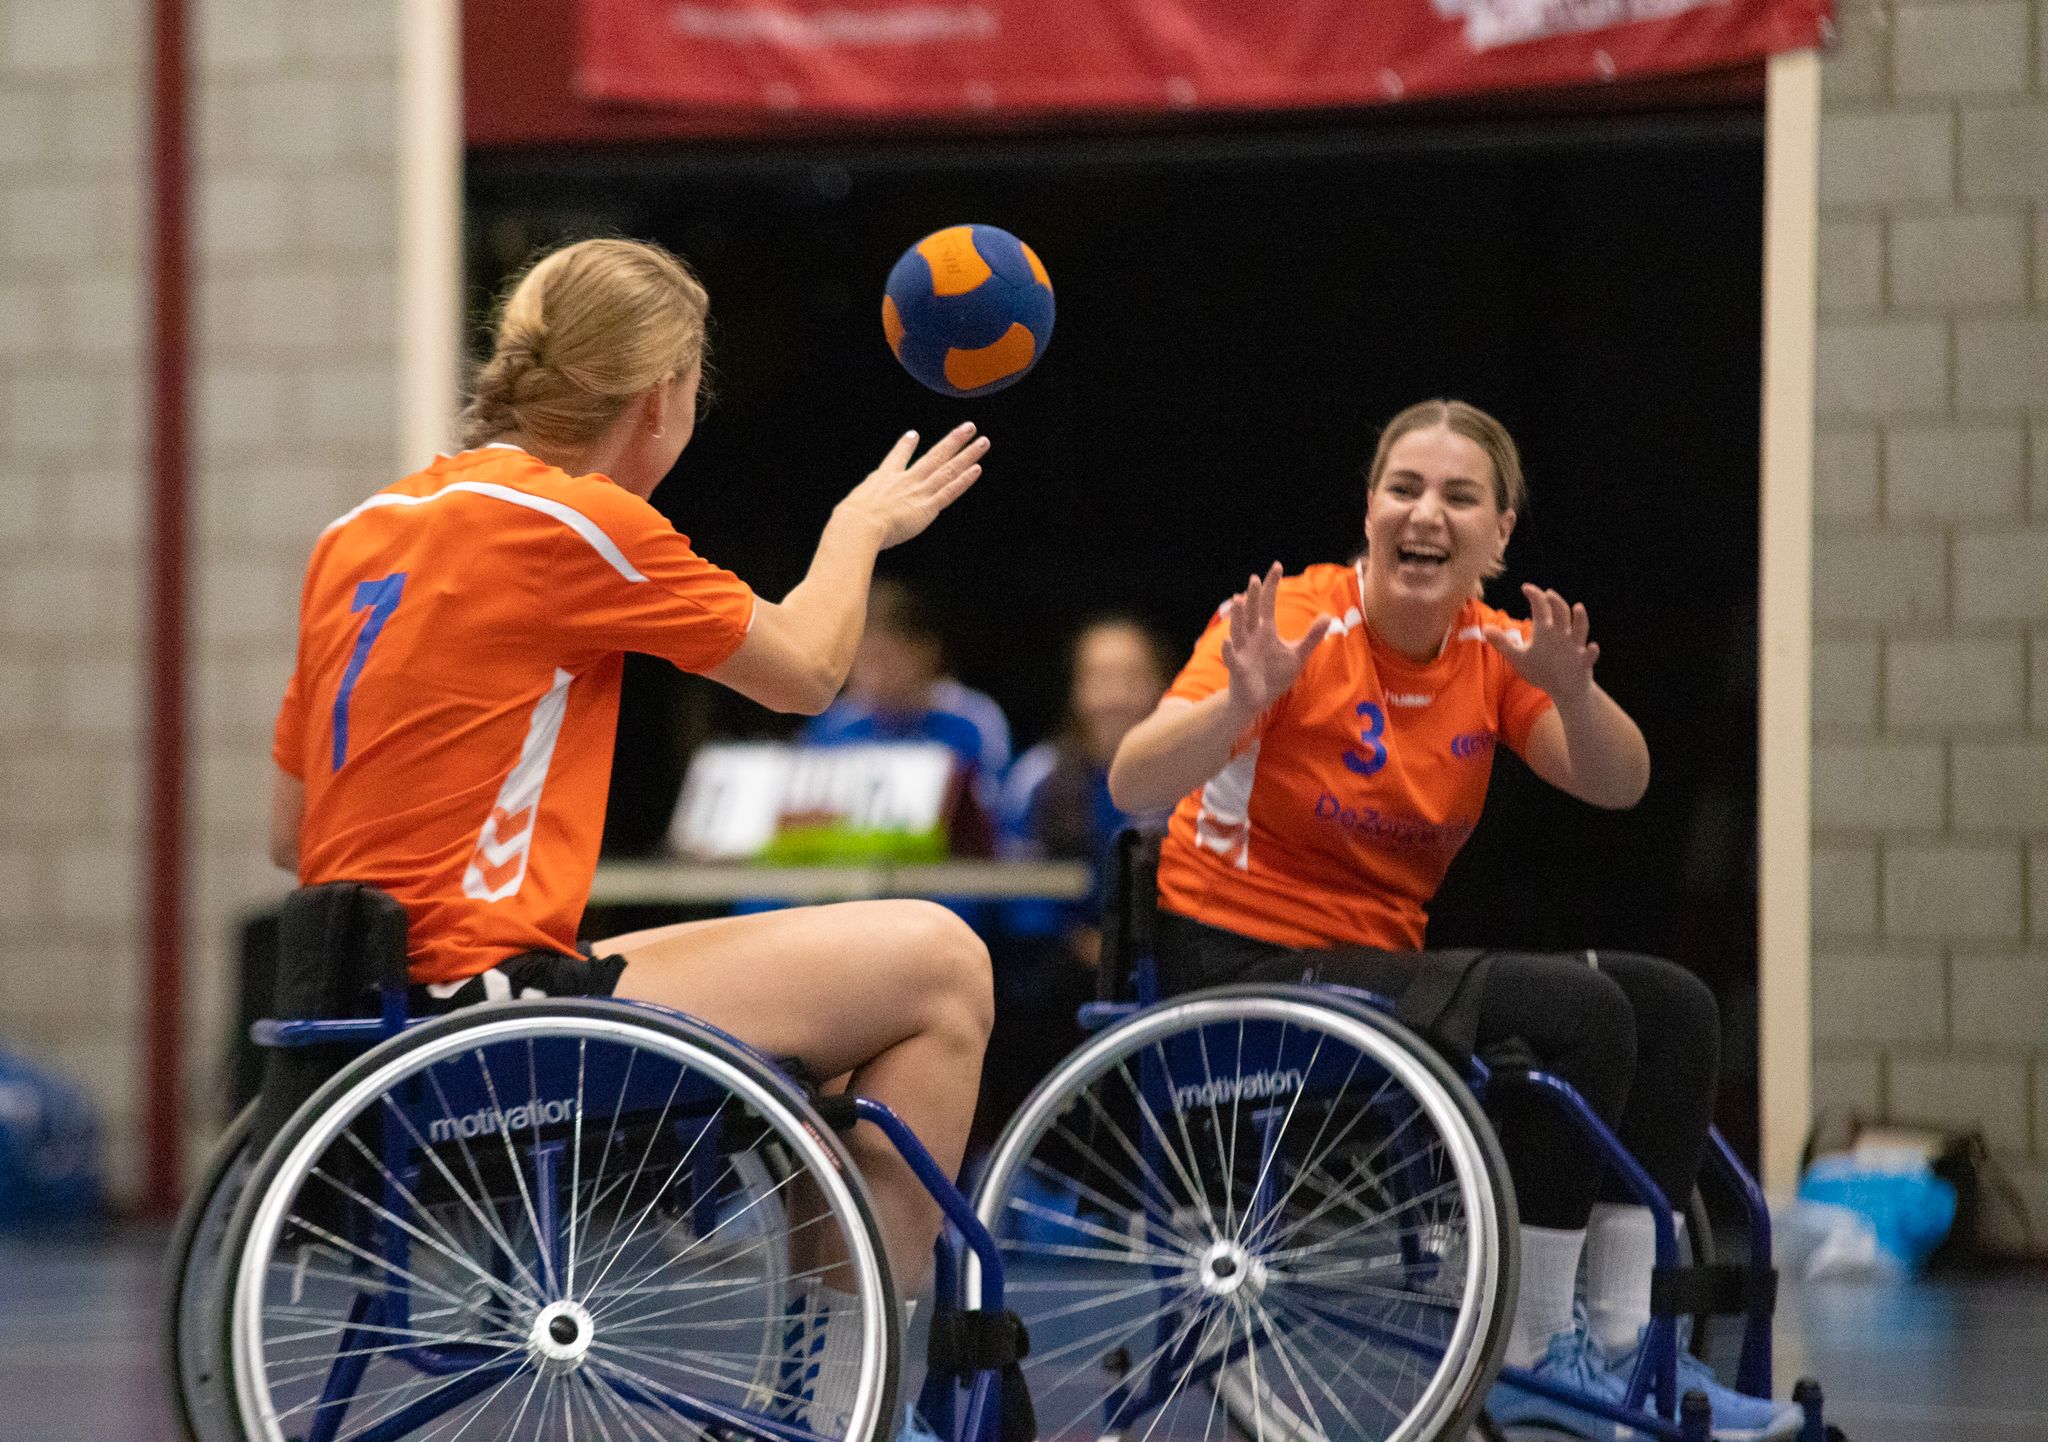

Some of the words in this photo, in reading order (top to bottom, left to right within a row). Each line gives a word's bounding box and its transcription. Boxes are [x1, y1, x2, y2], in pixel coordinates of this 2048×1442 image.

[333, 572, 408, 773] 7
[1343, 702, 1388, 777] 3
[1177, 1068, 1303, 1108] motivation
